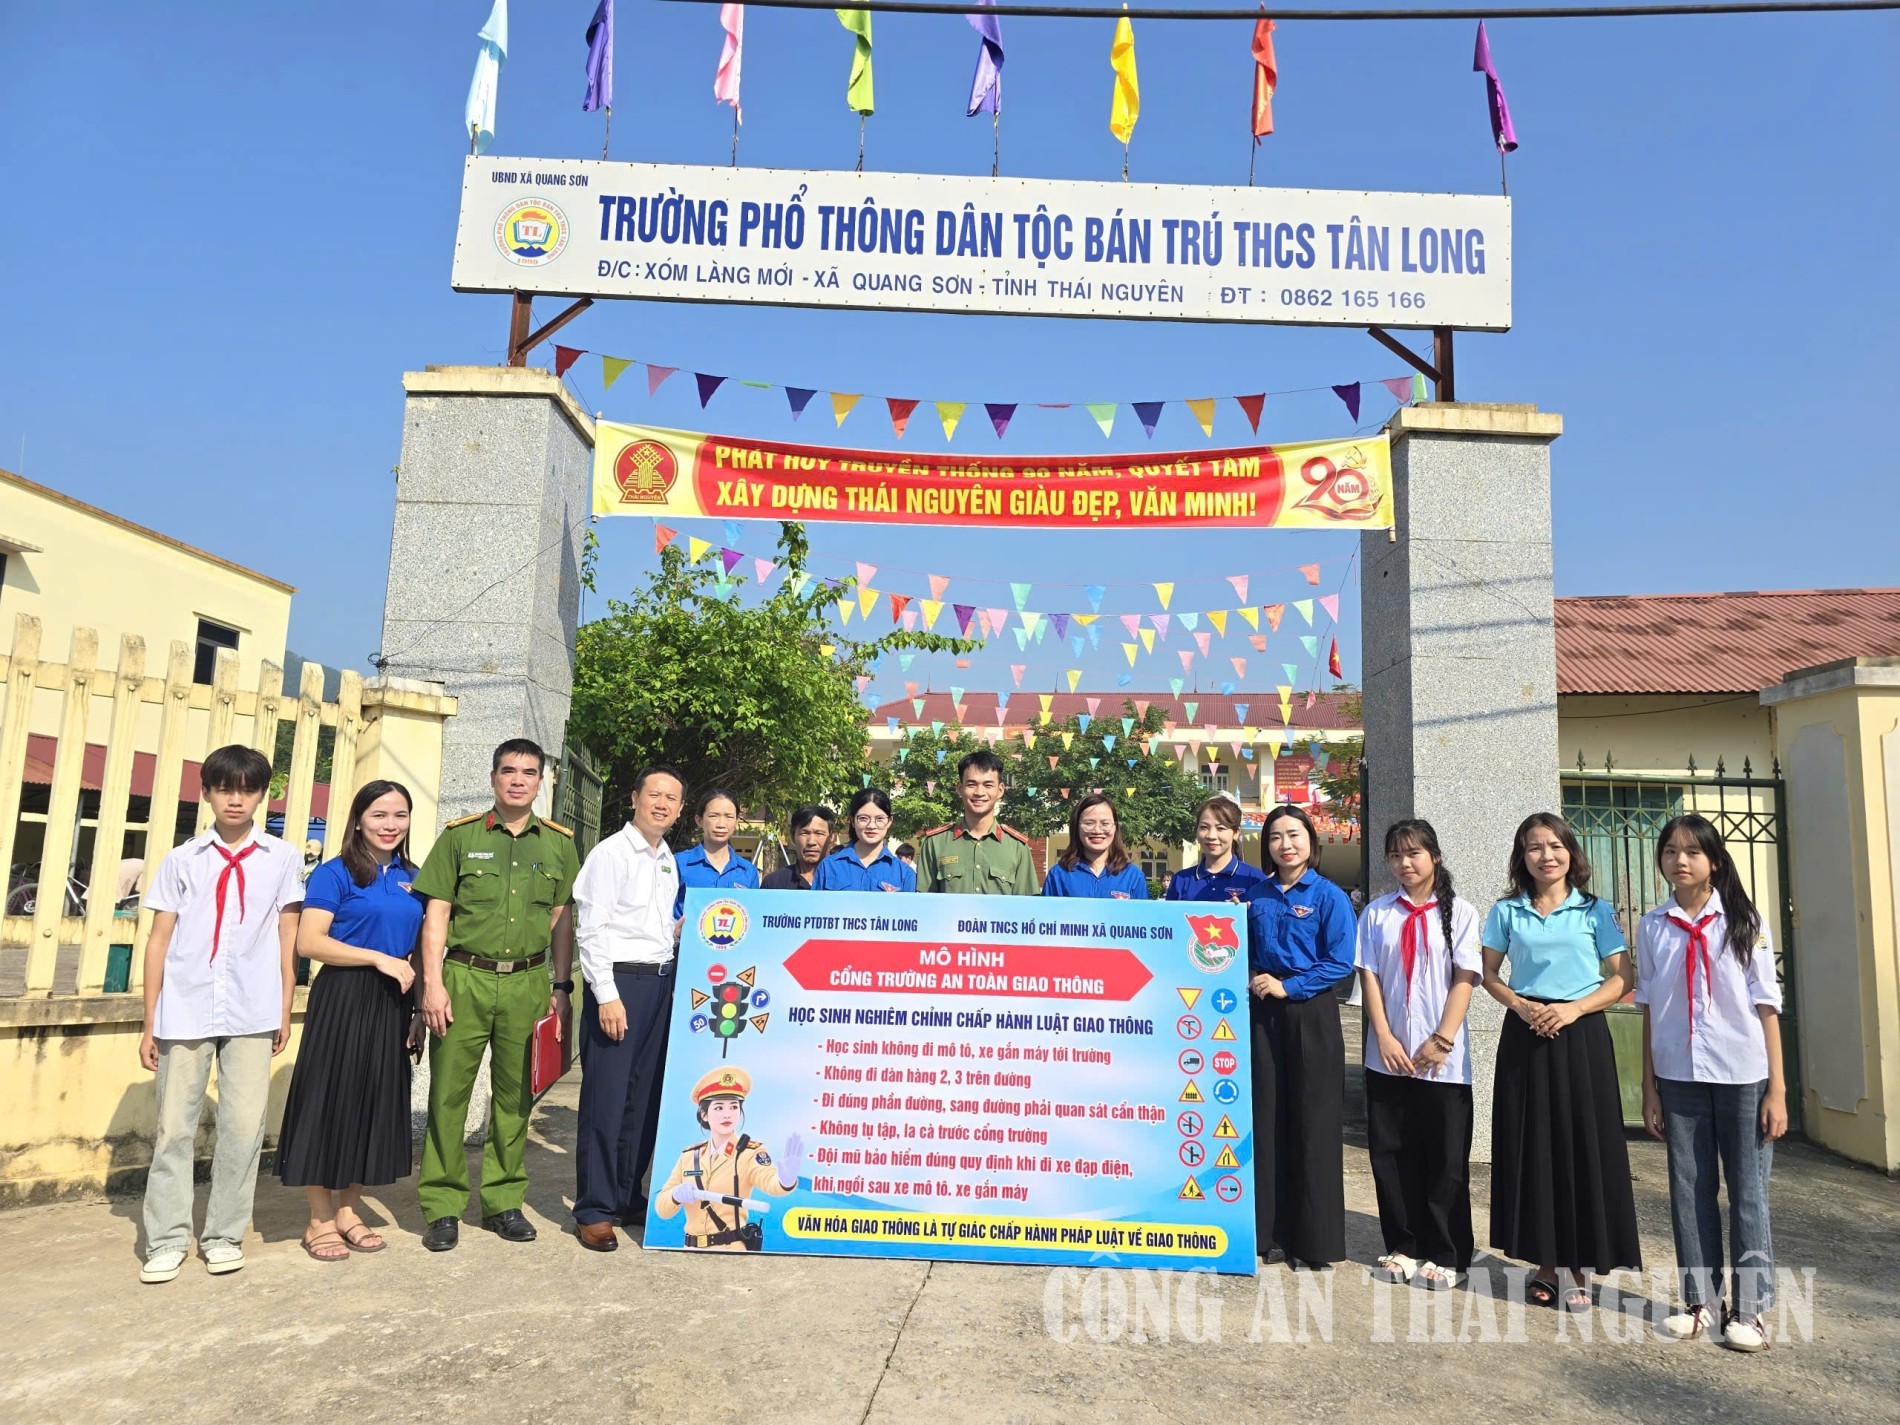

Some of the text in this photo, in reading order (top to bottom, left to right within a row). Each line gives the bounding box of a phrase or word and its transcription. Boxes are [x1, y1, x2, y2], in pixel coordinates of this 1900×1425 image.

[492, 171, 589, 186] UBND XÃ QUANG SƠN
[522, 225, 542, 237] TL
[599, 183, 1486, 275] TRƯỜNG PHỔ THÔNG DÂN TỘC BÁN TRÚ THCS TÂN LONG
[645, 257, 1426, 309] XÓM LÀNG MỚI XÃ QUANG SƠN TỈNH THÁI NGUYÊN ĐT 0862 165 166
[716, 445, 777, 469] PHÁT
[1301, 456, 1369, 503] 90
[1337, 482, 1360, 494] NĂM
[715, 479, 1256, 522] XÂY DỰNG THÁI NGUYÊN GIÀU ĐẸP, VĂN MINH!
[718, 919, 730, 927] TL
[763, 913, 801, 929] TRƯỜNG
[804, 916, 840, 930] PTDTBT
[843, 917, 867, 930] THCS
[870, 916, 889, 931] TÂN
[892, 918, 918, 932] LONG
[958, 918, 1173, 940] ĐOÀN TNCS HỒ CHÍ MINH XÃ QUANG SƠN
[919, 946, 1004, 967] MÔ HÌNH
[830, 965, 1104, 994] CỔNG TRƯỜNG AN TOÀN GIAO THÔNG
[693, 1018, 705, 1029] 50
[788, 1006, 1153, 1035] HỌC SINH NGHIÊM CHỈNH CHẤP HÀNH LUẬT GIAO THÔNG
[826, 1039, 1111, 1065] Học sinh không đi mô tô, xe gắn máy tới trường
[1214, 1057, 1235, 1069] STOP
[824, 1066, 1031, 1089] Không đi dàn hàng 2, 3 trên đường
[822, 1092, 1165, 1124] Đi đúng phần đường, sang đường phải quan sát cẩn thận
[820, 1120, 1048, 1145] Không tụ tập, la cà trước cổng trường
[817, 1148, 1133, 1179] Đội mũ bảo hiểm đúng quy định khi đi xe đạp điện,
[814, 1175, 1028, 1201] khi ngồi sau xe mô xe gắn máy
[798, 1214, 1216, 1250] VĂN HÓA GIAO THÔNG LÀ TỰ GIÁC CHẤP HÀNH PHÁP LUẬT VỀ GIAO THÔNG
